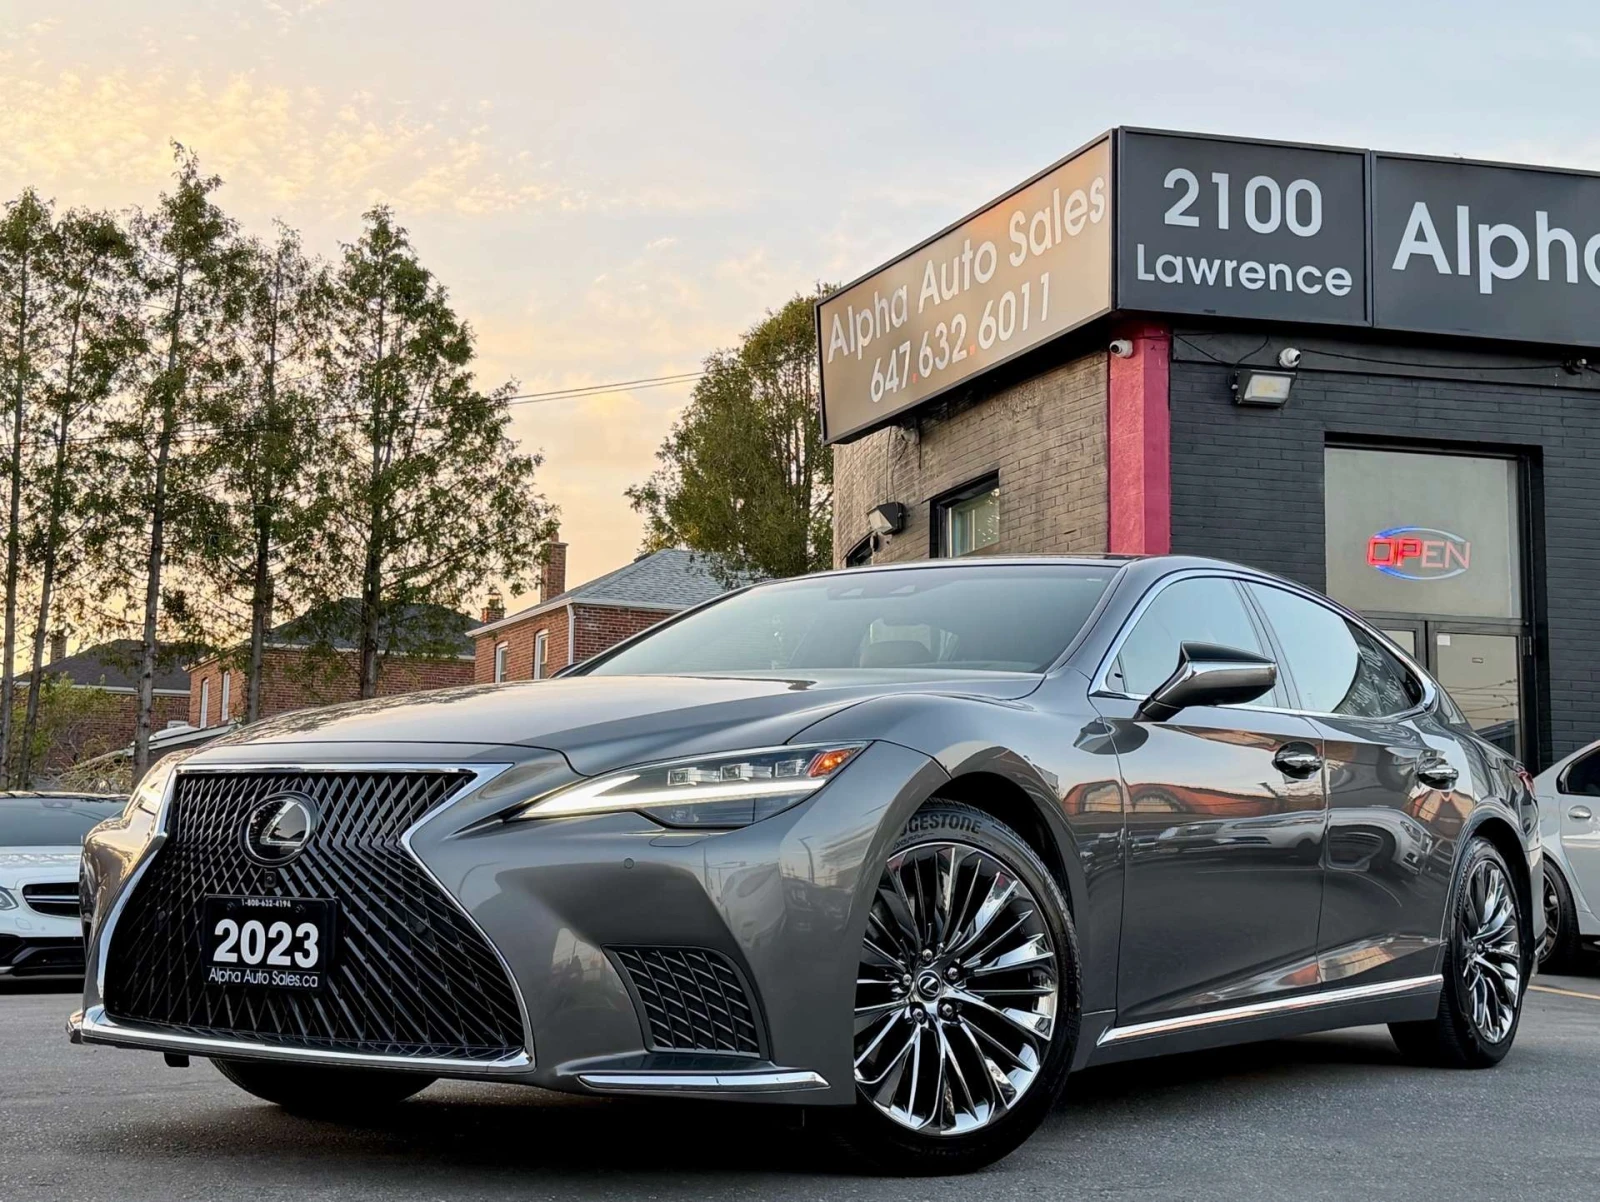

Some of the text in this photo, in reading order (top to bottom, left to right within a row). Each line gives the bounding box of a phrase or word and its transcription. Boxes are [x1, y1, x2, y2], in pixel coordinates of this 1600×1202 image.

[1163, 168, 1322, 237] 2100
[828, 176, 1106, 364] Alpha Auto Sales
[1137, 243, 1353, 297] Lawrence
[870, 271, 1050, 403] 647.632.6011
[1367, 537, 1472, 569] OPEN
[213, 918, 319, 969] 2023
[208, 966, 319, 988] Alpha Auto Sales.ca
